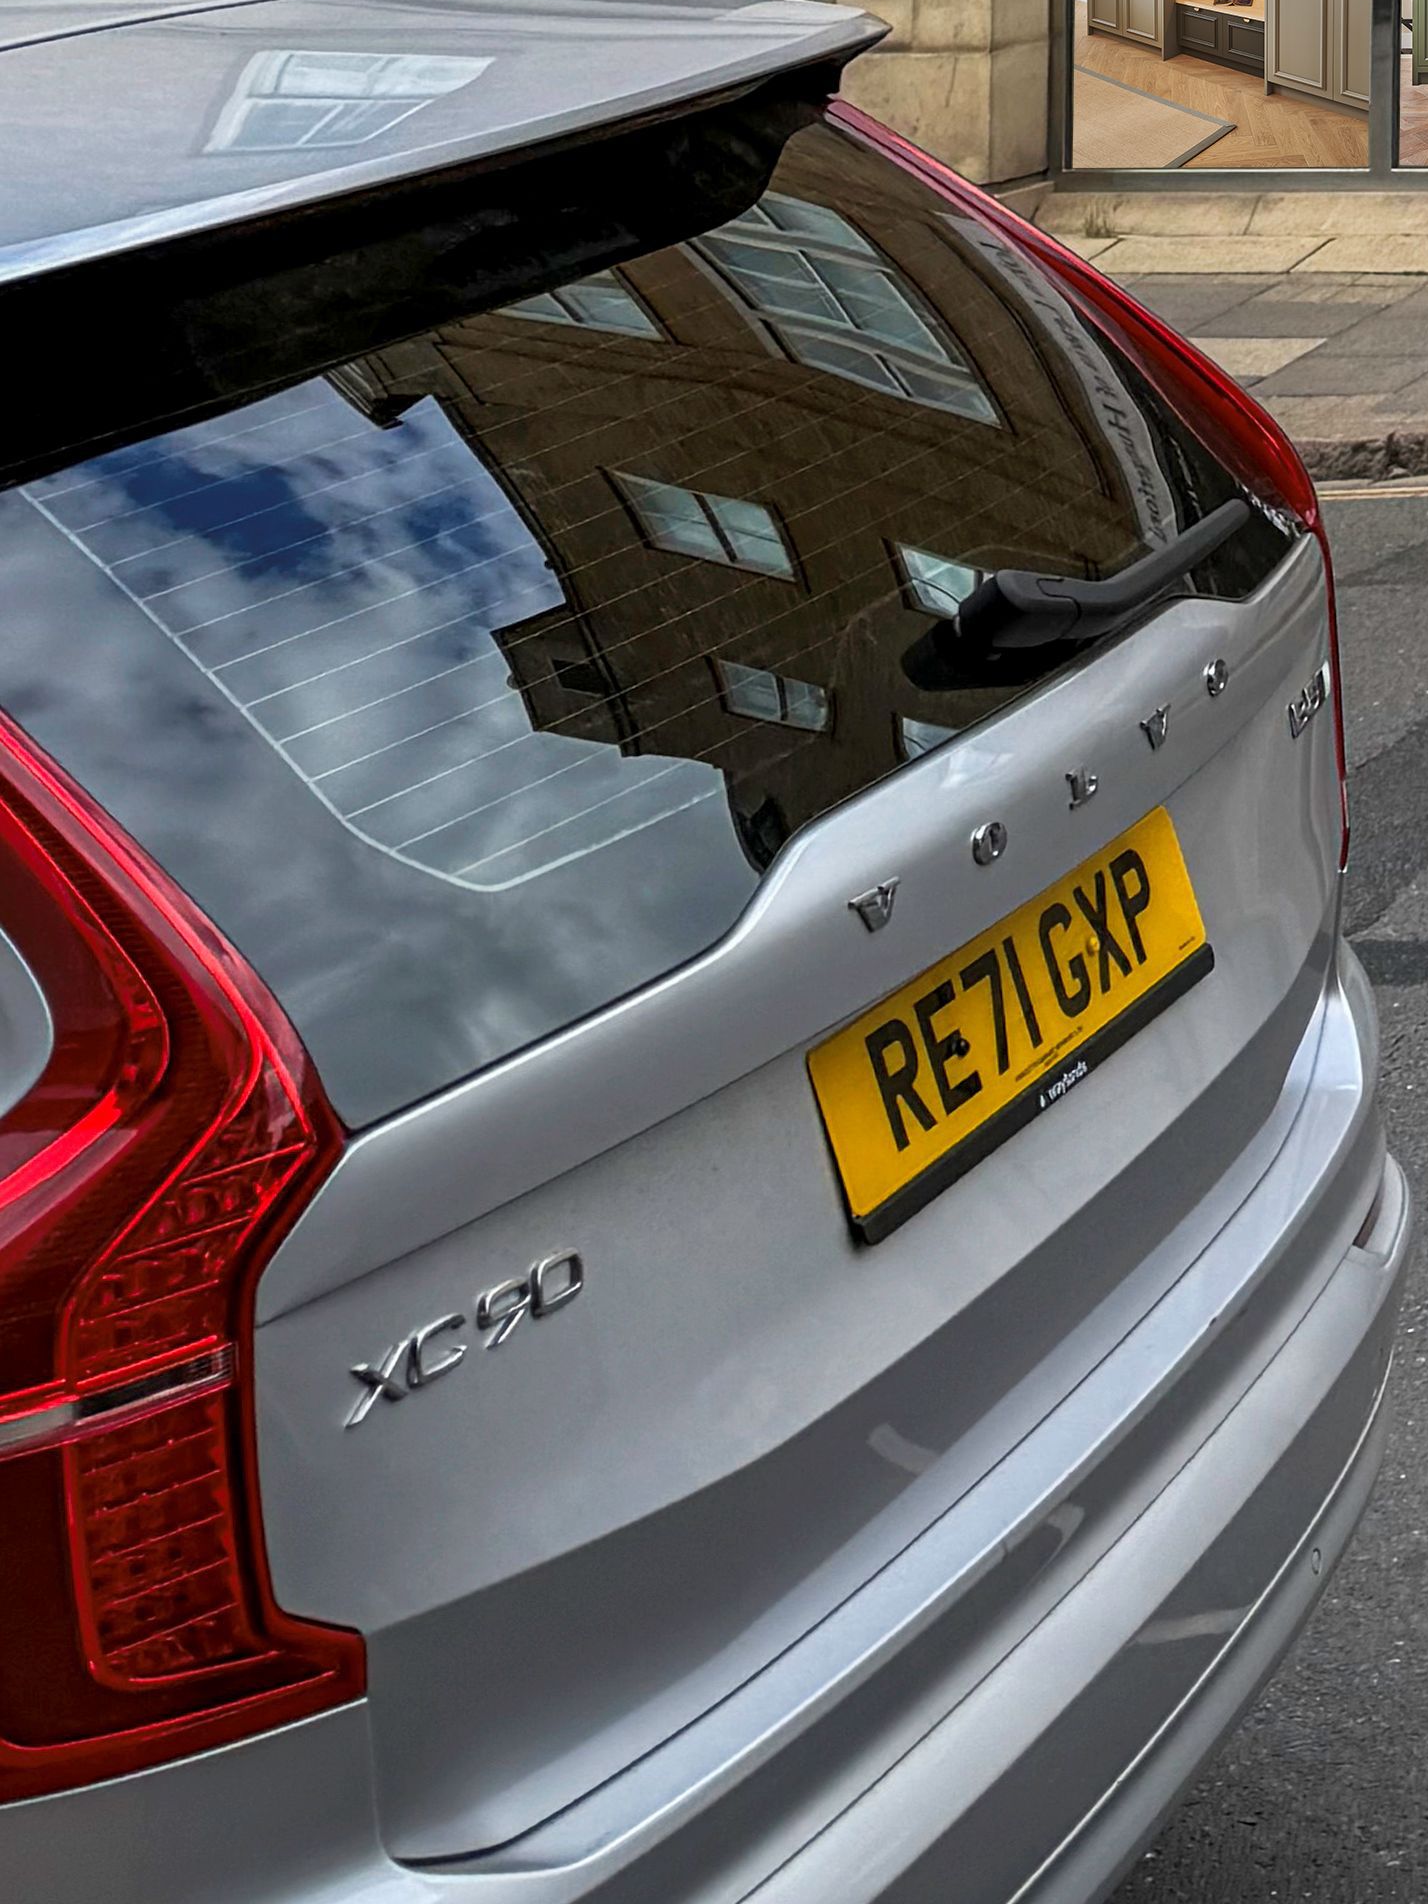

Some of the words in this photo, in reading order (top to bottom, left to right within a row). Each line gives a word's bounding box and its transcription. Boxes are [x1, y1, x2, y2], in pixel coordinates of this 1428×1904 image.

[847, 658, 1229, 932] VOLVO
[864, 935, 1042, 1151] RE71
[1038, 848, 1150, 1018] GXP
[344, 1246, 586, 1429] XC90
